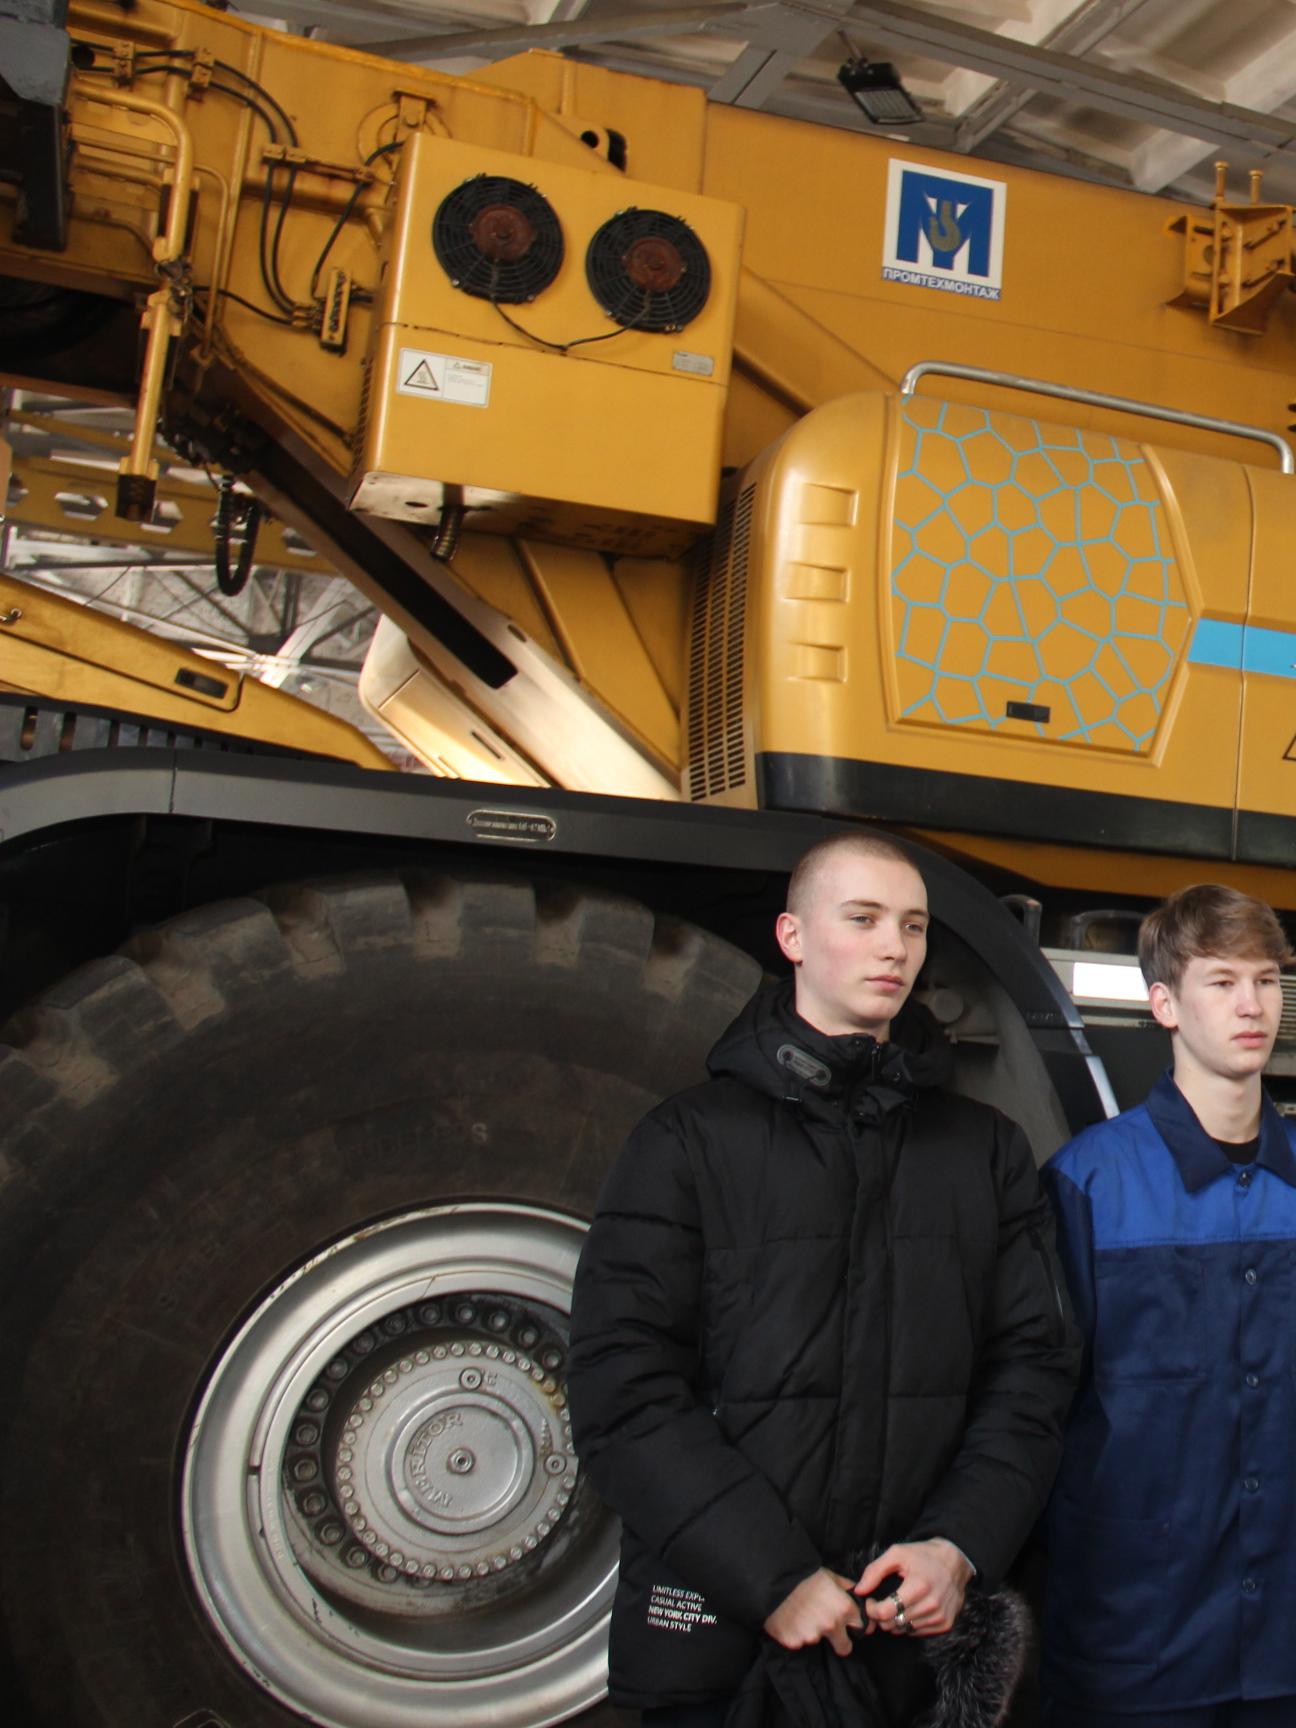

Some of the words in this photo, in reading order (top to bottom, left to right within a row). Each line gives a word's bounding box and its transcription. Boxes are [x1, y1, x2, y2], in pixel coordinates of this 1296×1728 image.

[882, 267, 1000, 300] ПРОМТЕХМОНТАЖ
[652, 1584, 685, 1598] LIMITLESS
[650, 1595, 675, 1607] CASUAL
[676, 1601, 702, 1612] ACTIVE
[648, 1605, 664, 1617] NEW
[683, 1612, 701, 1623] CITY
[647, 1616, 670, 1628] URBAN
[670, 1621, 692, 1633] STYLE
